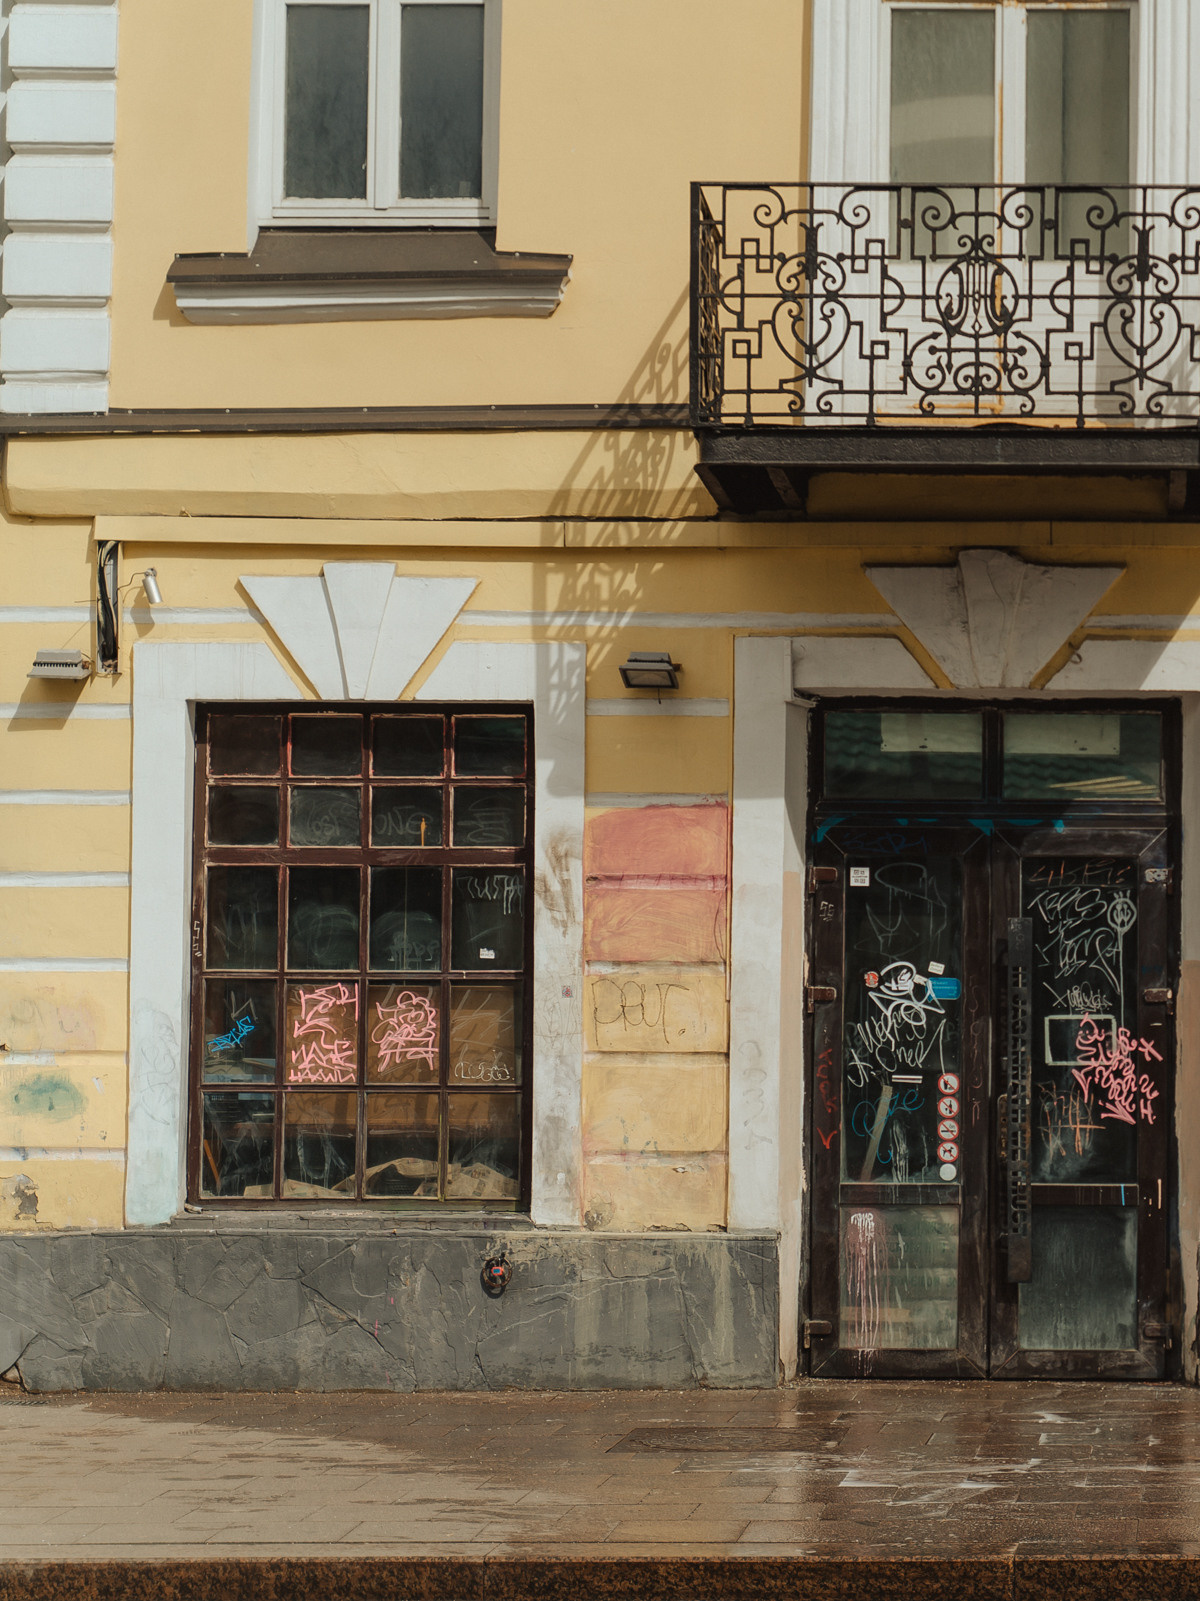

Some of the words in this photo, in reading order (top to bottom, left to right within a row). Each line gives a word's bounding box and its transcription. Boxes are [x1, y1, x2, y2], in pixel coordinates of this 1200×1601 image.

[1011, 966, 1027, 988] IN
[1010, 1131, 1028, 1162] WE
[1011, 1170, 1028, 1236] TRUST
